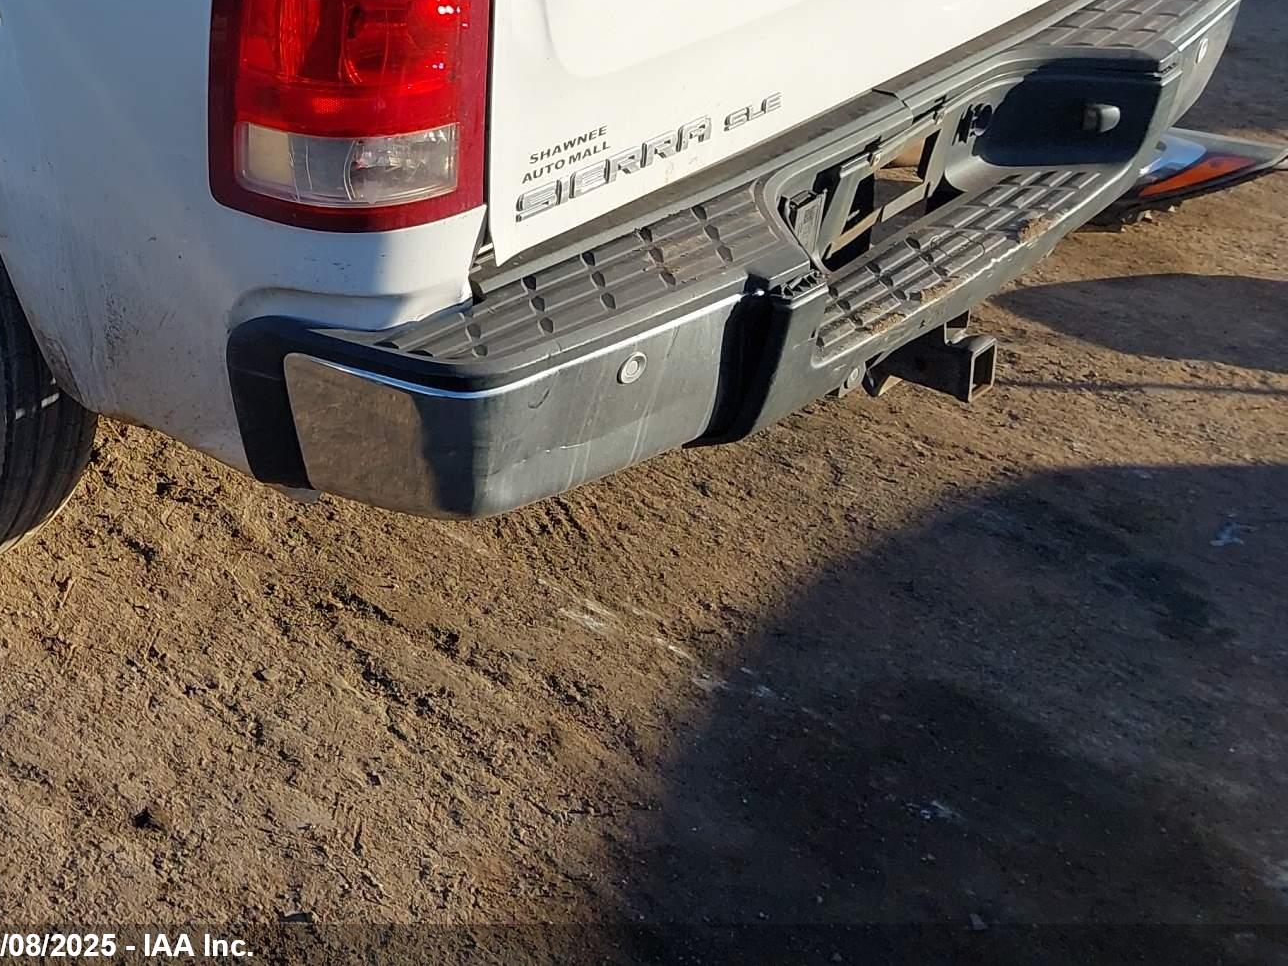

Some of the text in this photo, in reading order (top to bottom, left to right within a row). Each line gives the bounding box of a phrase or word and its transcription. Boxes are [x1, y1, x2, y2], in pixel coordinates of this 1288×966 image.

[515, 91, 783, 223] SIERRA SLE
[521, 140, 611, 184] AUTO MALL
[528, 125, 608, 165] SHAWNEE
